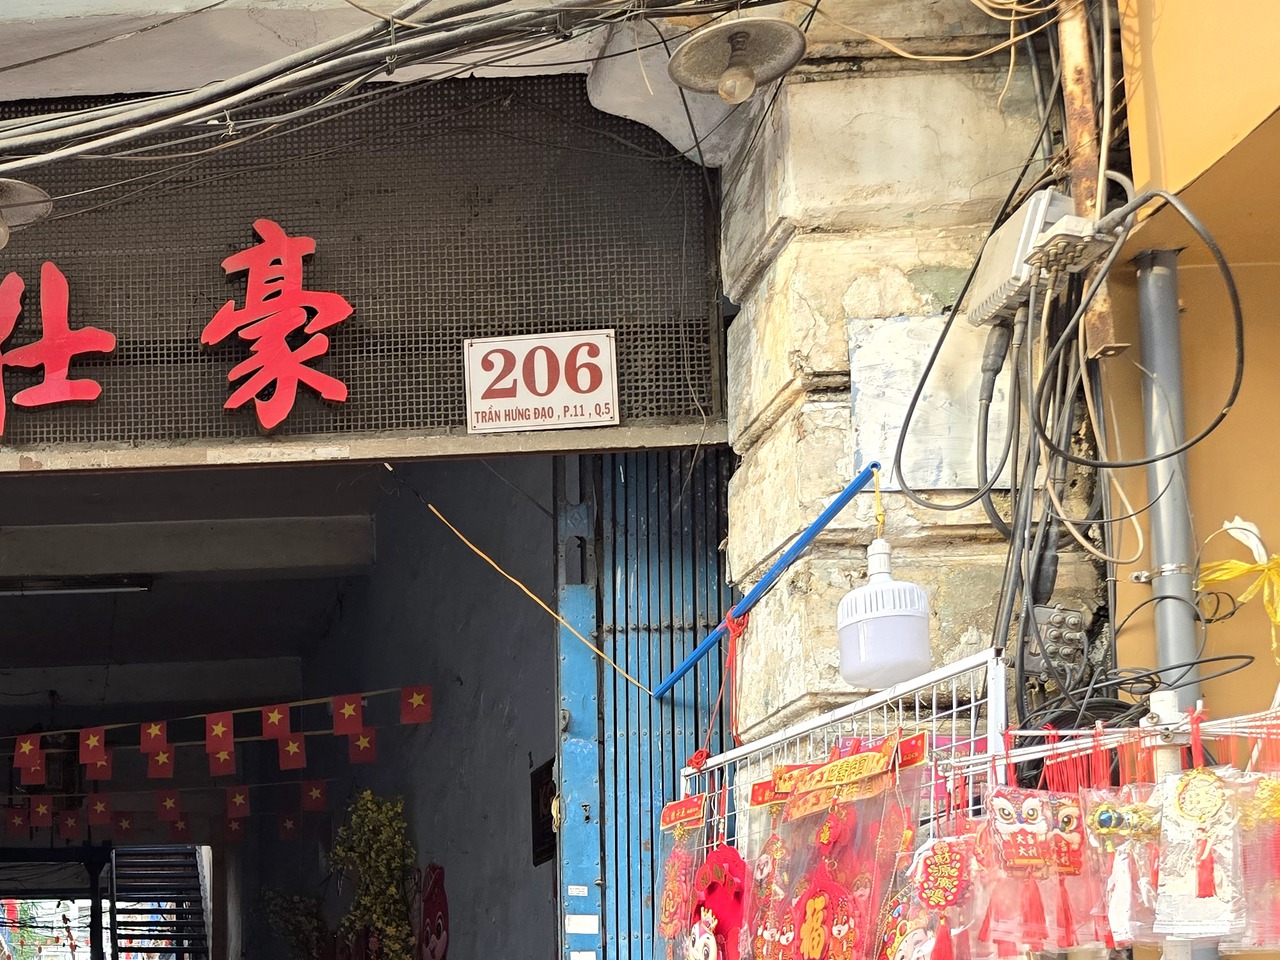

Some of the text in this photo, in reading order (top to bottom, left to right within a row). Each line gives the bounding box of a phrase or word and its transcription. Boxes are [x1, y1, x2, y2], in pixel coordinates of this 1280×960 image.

[481, 342, 603, 400] 206
[475, 405, 501, 424] TRẦN
[504, 406, 531, 422] HƯNG
[534, 406, 554, 422] ĐẠO
[563, 404, 585, 418] P.11
[594, 402, 611, 417] Q.5
